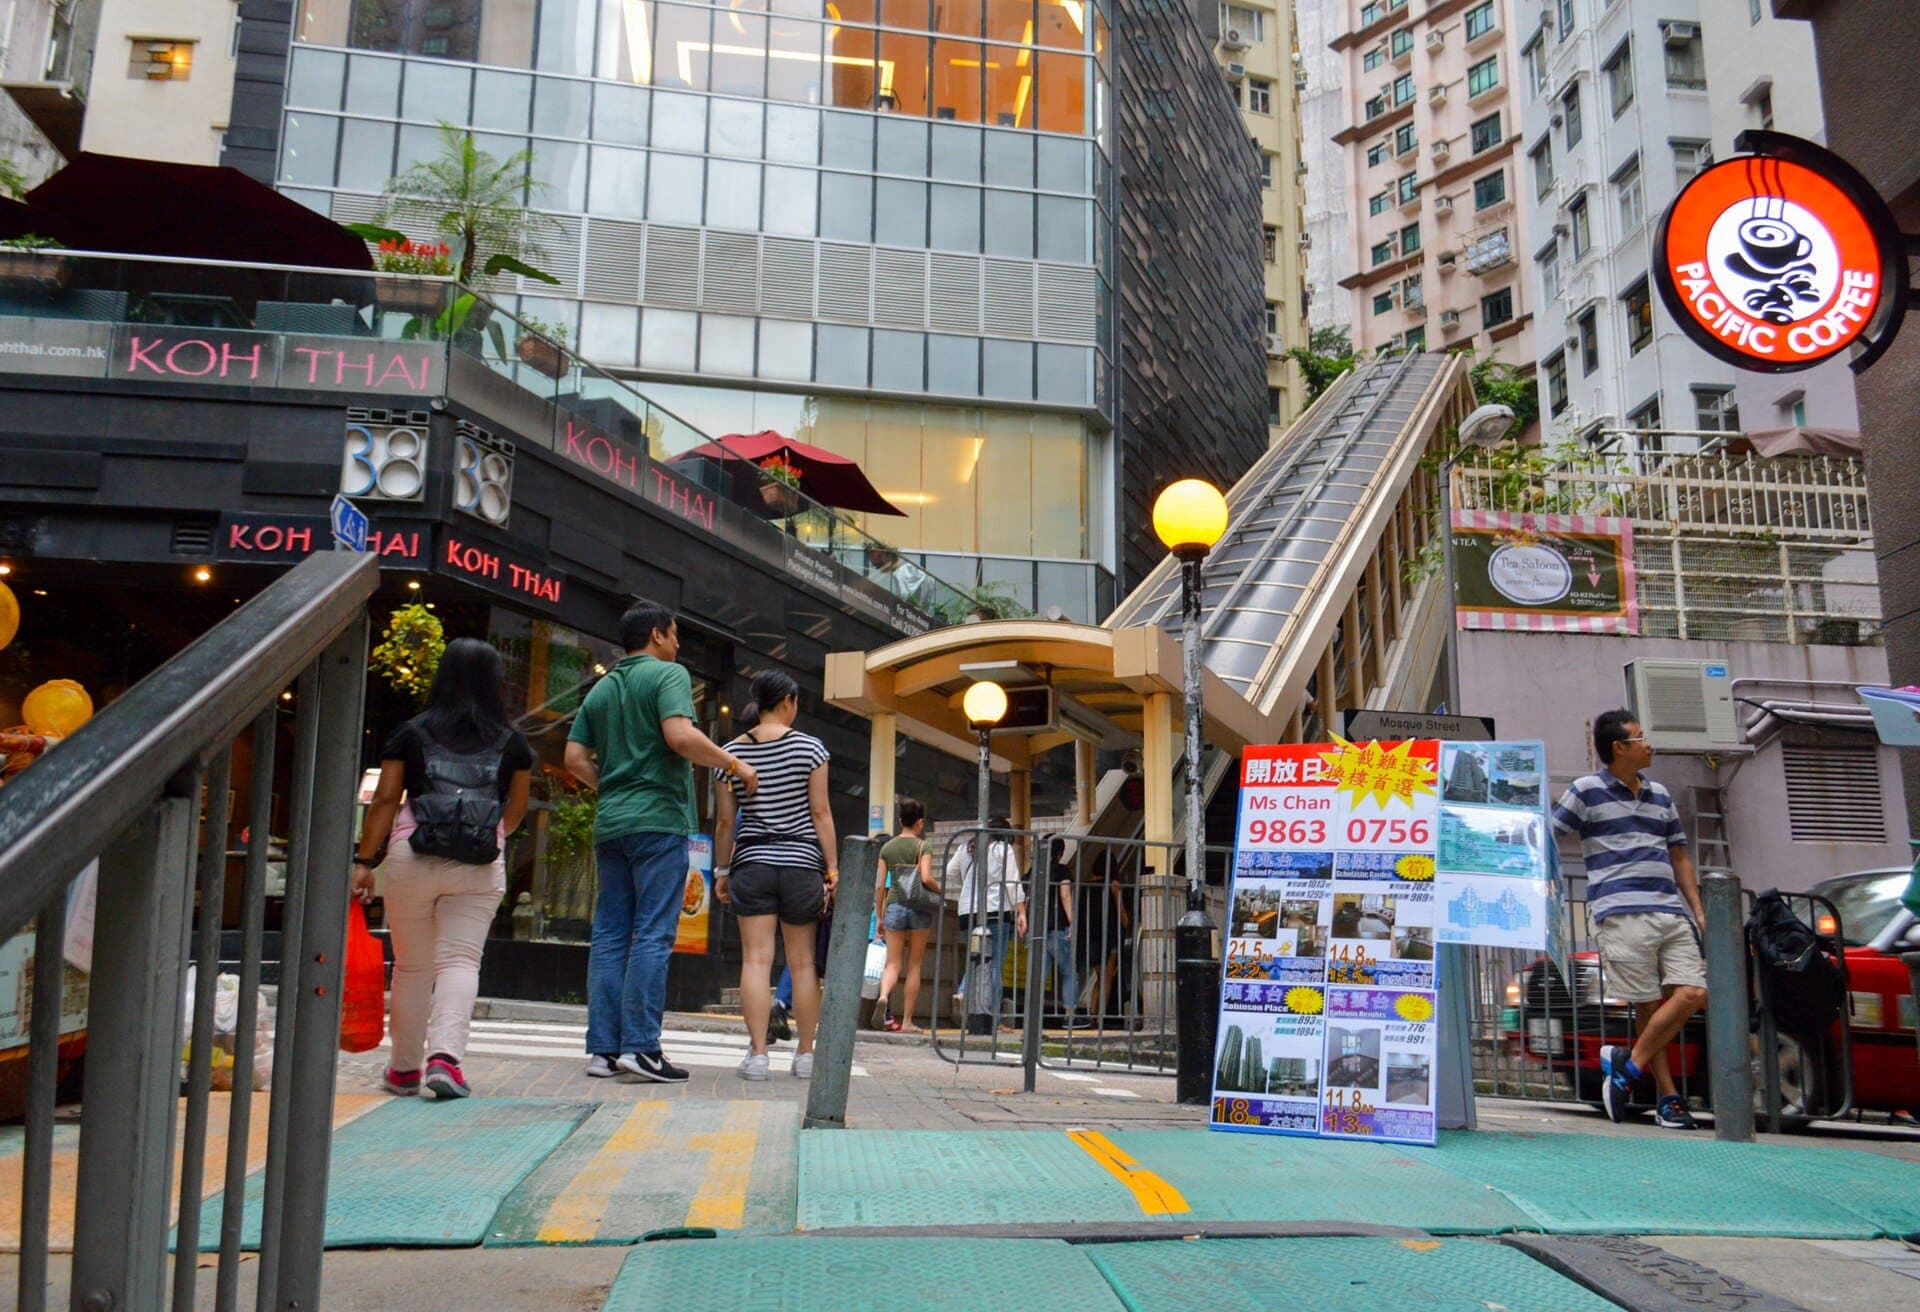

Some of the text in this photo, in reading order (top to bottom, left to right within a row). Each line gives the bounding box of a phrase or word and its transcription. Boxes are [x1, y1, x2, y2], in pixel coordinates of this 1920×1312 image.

[1676, 262, 1874, 354] PACIFIC COFFEE
[127, 336, 260, 380] KOH
[295, 347, 430, 390] THAI
[346, 424, 424, 499] 38
[457, 438, 511, 523] 38
[566, 420, 714, 530] KOH THAI
[229, 524, 420, 558] KOH HAI
[1499, 556, 1560, 571] Tea Saloon
[447, 539, 561, 603] KOH THAI
[1379, 716, 1461, 732] Mosque Street
[1249, 795, 1331, 810] Ms Chan
[1249, 819, 1327, 844] 9863
[1346, 818, 1430, 844] 0756
